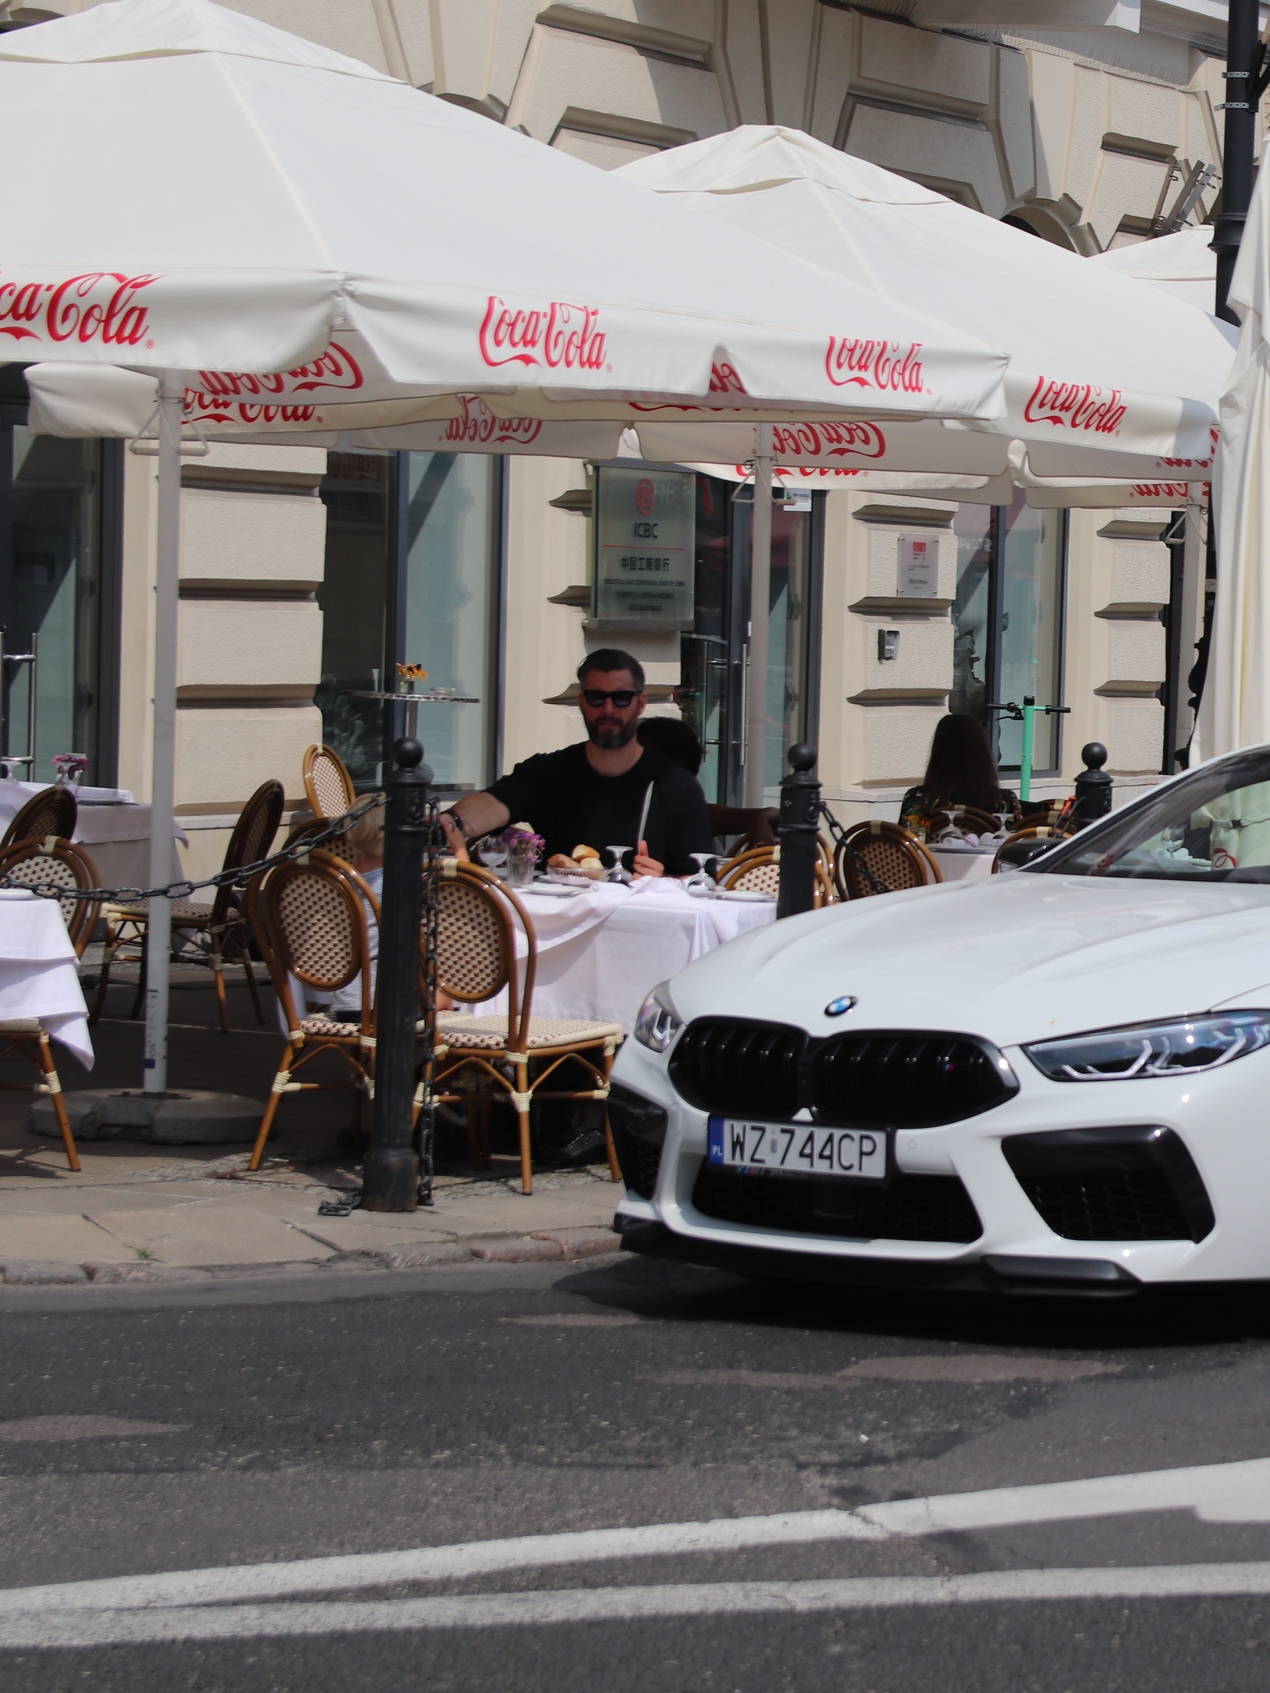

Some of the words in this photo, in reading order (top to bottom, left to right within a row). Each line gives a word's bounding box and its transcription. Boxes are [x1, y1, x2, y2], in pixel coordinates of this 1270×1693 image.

[479, 295, 608, 370] Coca-Cola
[825, 335, 924, 393] Coca-Cola
[1023, 375, 1128, 434] Coca-Cola
[633, 521, 659, 539] ICBC
[712, 1145, 723, 1156] PL
[780, 1128, 878, 1173] 744CP
